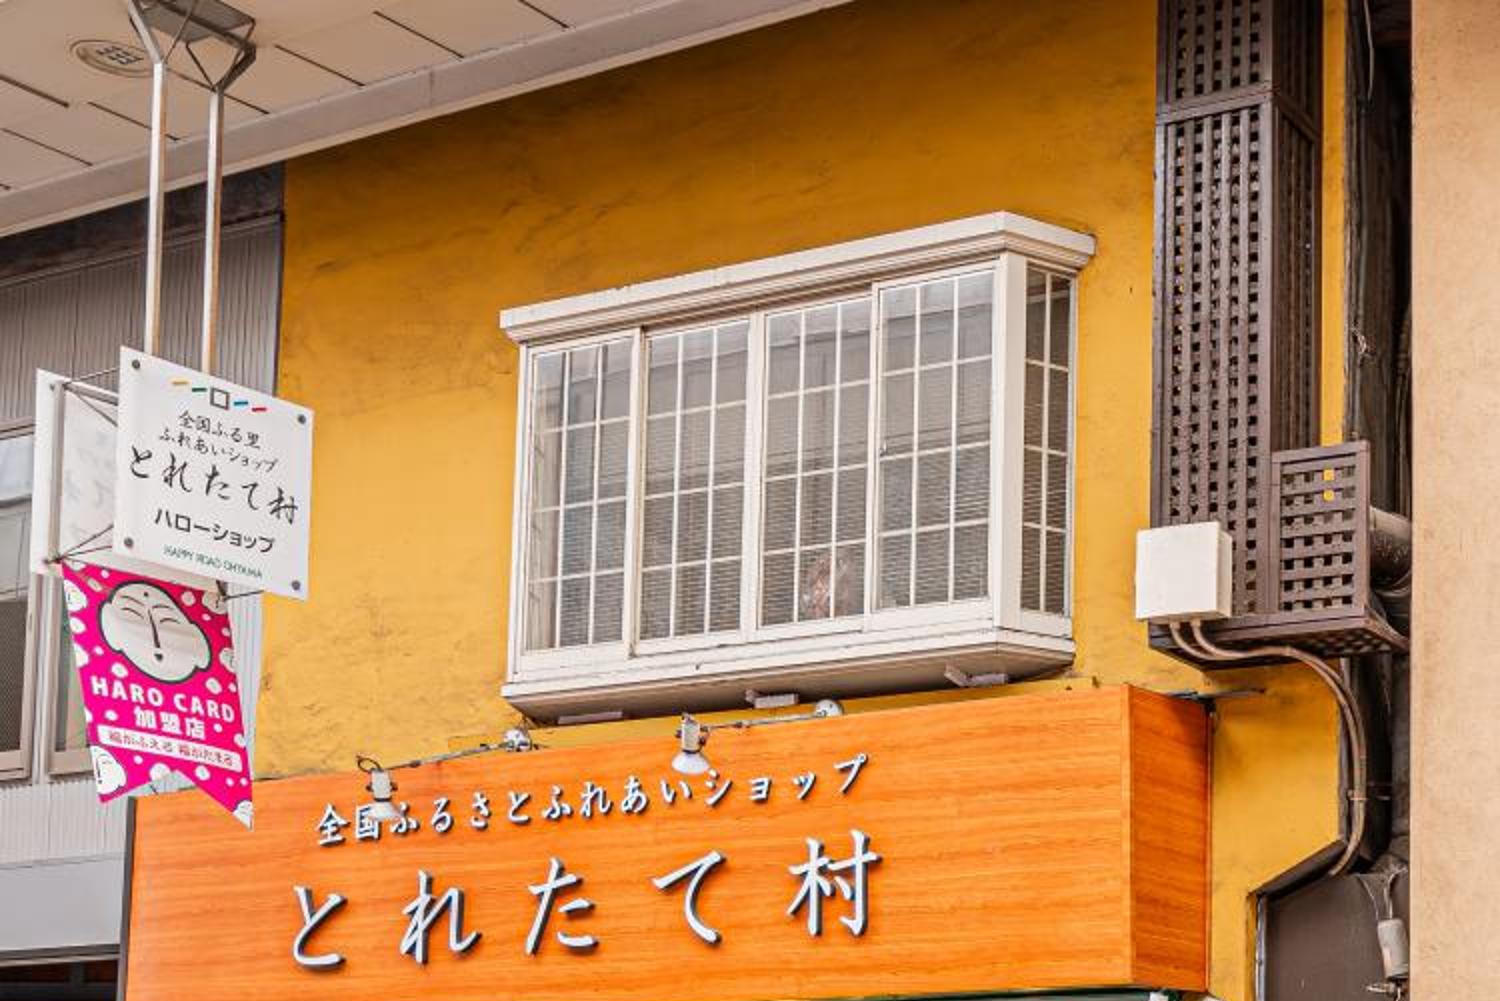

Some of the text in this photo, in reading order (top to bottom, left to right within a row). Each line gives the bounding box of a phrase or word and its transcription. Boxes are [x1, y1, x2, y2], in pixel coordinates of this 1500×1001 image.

[129, 445, 299, 525] とれたて村
[155, 508, 276, 553] ハローショップ
[90, 675, 235, 723] HARO CARD
[133, 706, 206, 740] 加盟店
[292, 829, 882, 969] とれたて村
